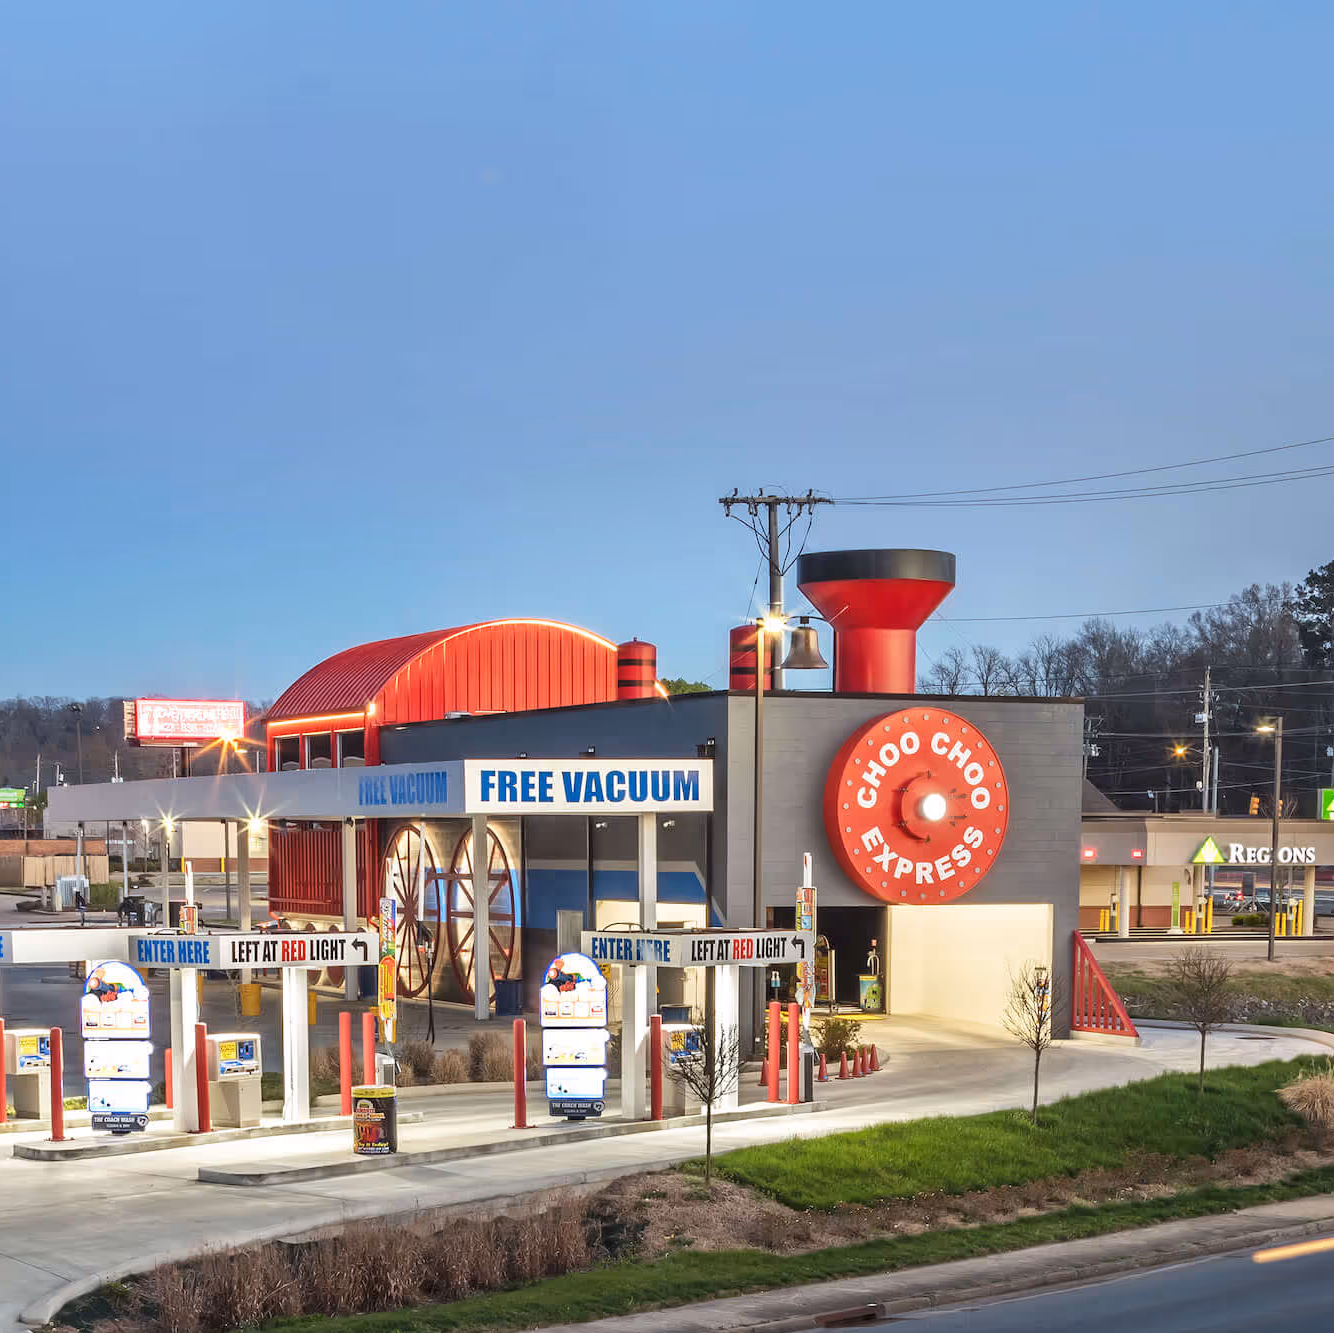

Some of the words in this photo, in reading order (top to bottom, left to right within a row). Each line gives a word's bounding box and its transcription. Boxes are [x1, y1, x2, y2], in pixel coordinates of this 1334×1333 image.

[857, 731, 920, 809] CHOO
[931, 732, 991, 810] CHOO
[357, 775, 387, 806] FREE
[389, 770, 447, 805] VACUUM
[480, 770, 554, 803] FREE
[561, 770, 700, 803] VACUUM
[860, 826, 984, 884] EXPRESS
[1228, 842, 1316, 864] REGONS
[137, 939, 175, 963] ENTER
[177, 940, 210, 964] HERE
[231, 941, 259, 963] LEFT
[262, 940, 278, 962] AT
[281, 939, 306, 961] RED
[309, 939, 346, 961] LIGHT
[591, 937, 633, 960] ENTER
[636, 938, 670, 962] HERE
[691, 940, 715, 961] LEFT
[717, 939, 731, 960] AT
[732, 938, 754, 959] RED
[756, 937, 787, 958] LIGHT
